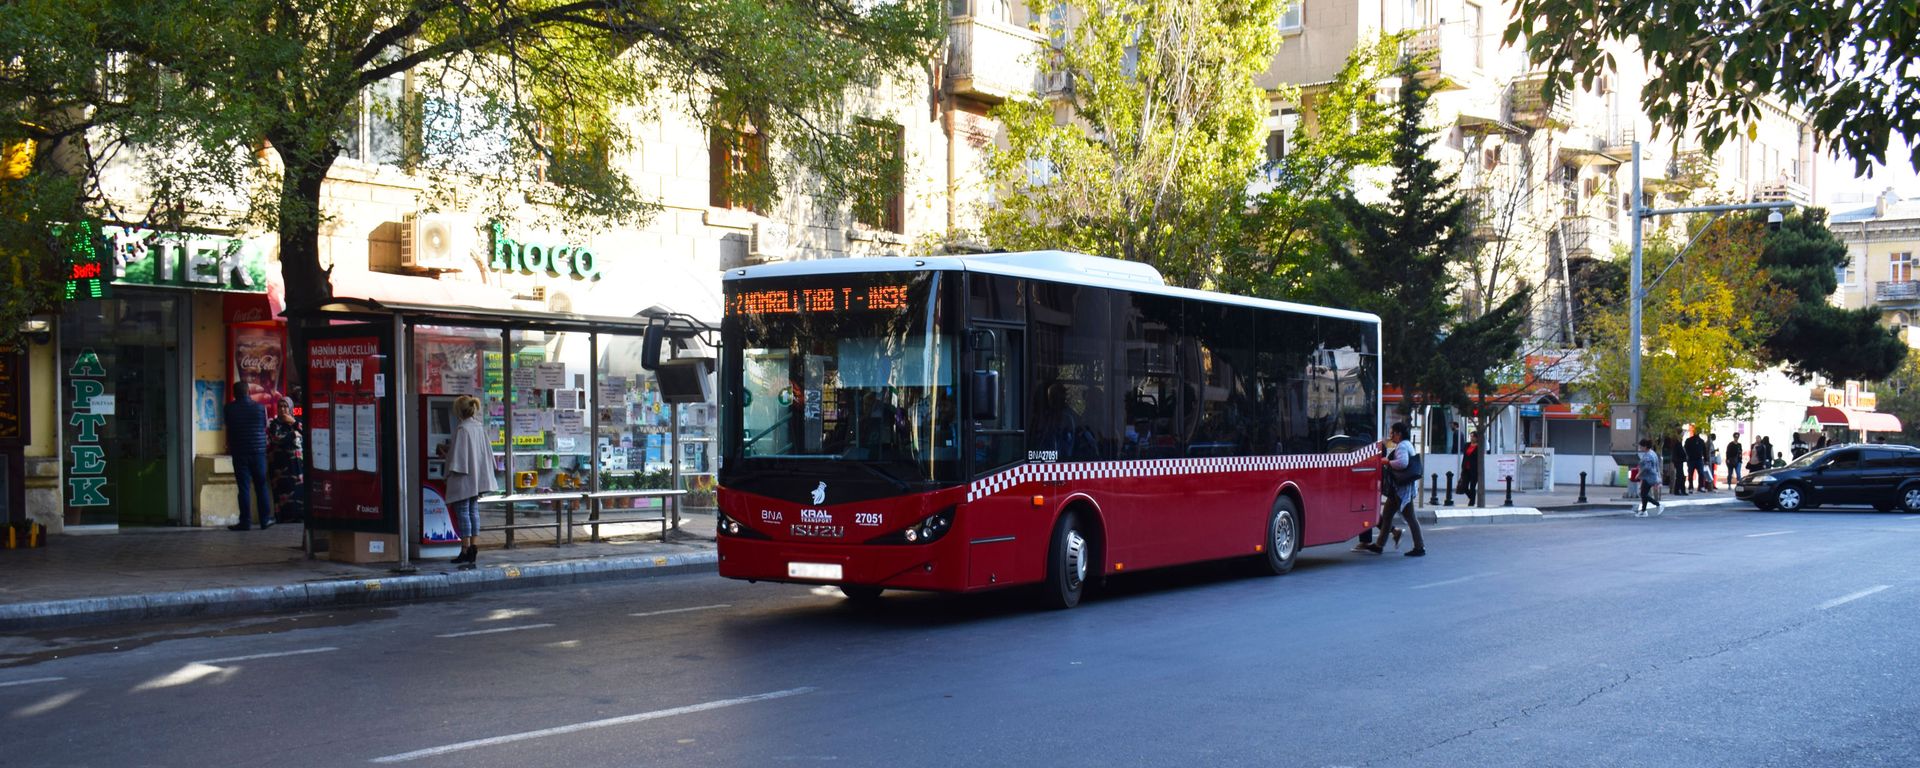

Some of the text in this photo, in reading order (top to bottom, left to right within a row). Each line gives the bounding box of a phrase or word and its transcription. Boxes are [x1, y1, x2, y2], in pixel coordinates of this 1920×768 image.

[69, 347, 110, 506] APTEK
[761, 509, 783, 521] BNA
[801, 509, 832, 518] KRAL
[855, 513, 883, 524] 27051
[790, 524, 844, 538] ISUZU
